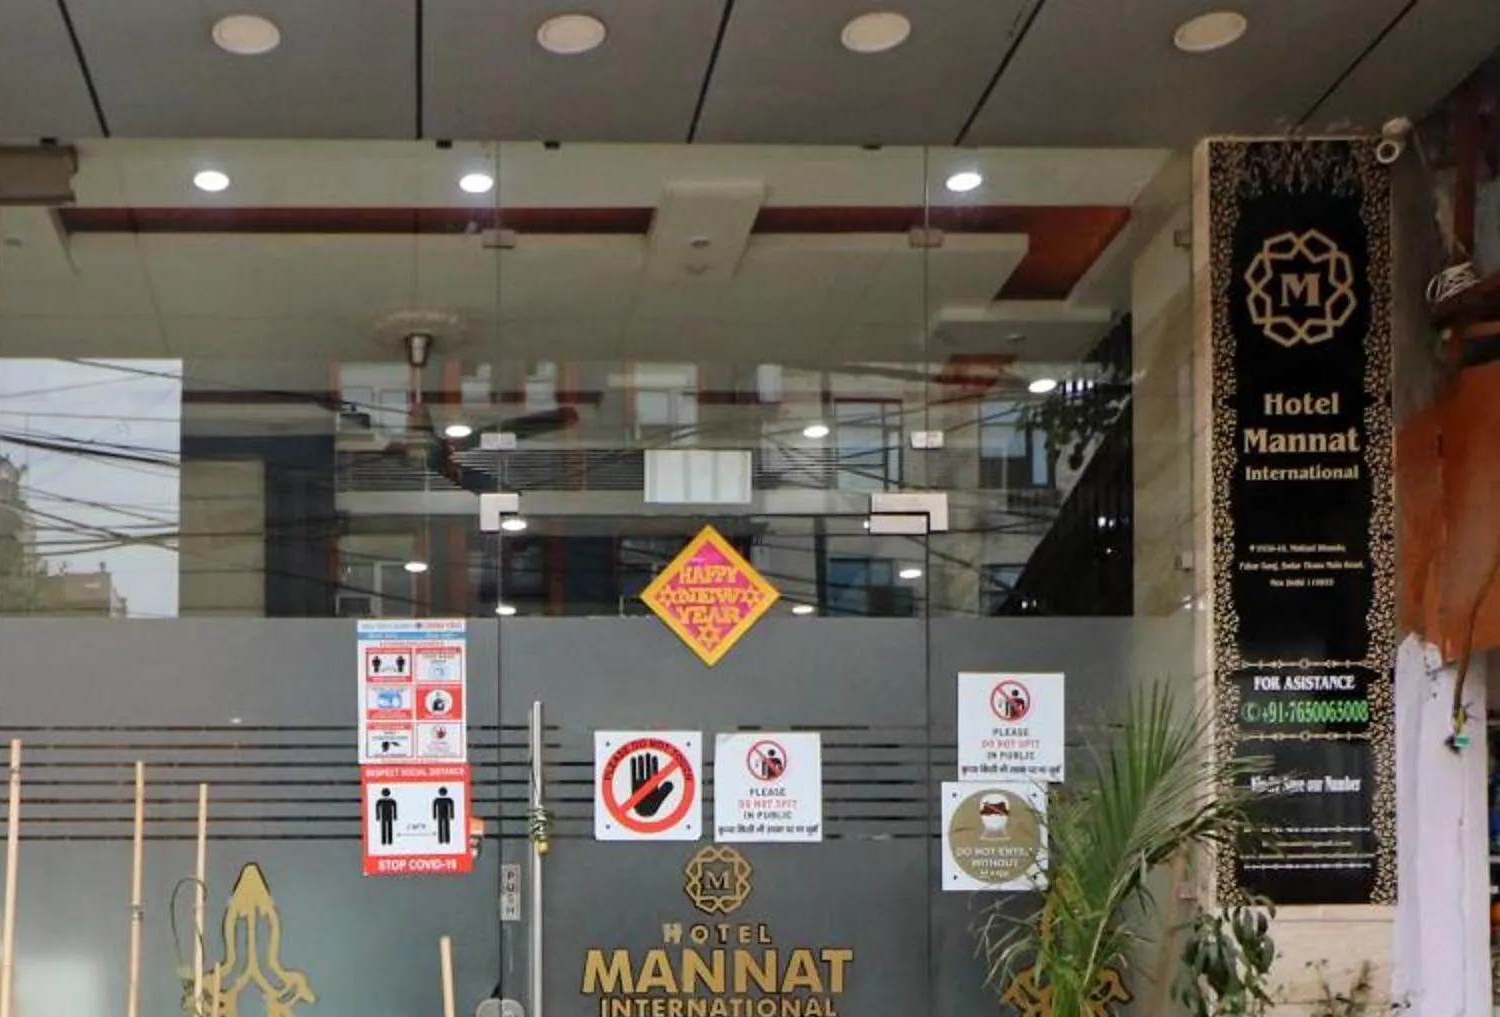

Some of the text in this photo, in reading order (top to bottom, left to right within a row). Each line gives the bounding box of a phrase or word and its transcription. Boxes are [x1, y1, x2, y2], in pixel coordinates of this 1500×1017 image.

[1280, 273, 1321, 307] M
[1263, 392, 1339, 416] Hotel
[1243, 427, 1361, 453] Mannat
[1245, 464, 1359, 481] International
[679, 564, 737, 585] HAPPY
[676, 587, 742, 604] NEW
[675, 605, 740, 625] YEAR
[1253, 675, 1355, 690] FOR ASISTANCE
[991, 728, 1029, 736] PLEASE
[981, 740, 996, 748] DO
[998, 740, 1016, 748] NOT
[987, 752, 1035, 760] IN PUBLIC
[428, 767, 465, 777] DISTANCE
[1325, 775, 1361, 792] Number
[749, 788, 786, 797] PLEASE
[739, 800, 797, 808] DO NOT SPIT
[743, 811, 792, 820] IN PUBLIC
[956, 847, 973, 857] DO
[975, 847, 995, 857] NOT
[378, 858, 457, 871] STOP COVID-19
[971, 858, 1019, 868] WITHOUT
[703, 870, 733, 890] M
[662, 922, 773, 945] HOTEL
[581, 948, 853, 994] MANNAT
